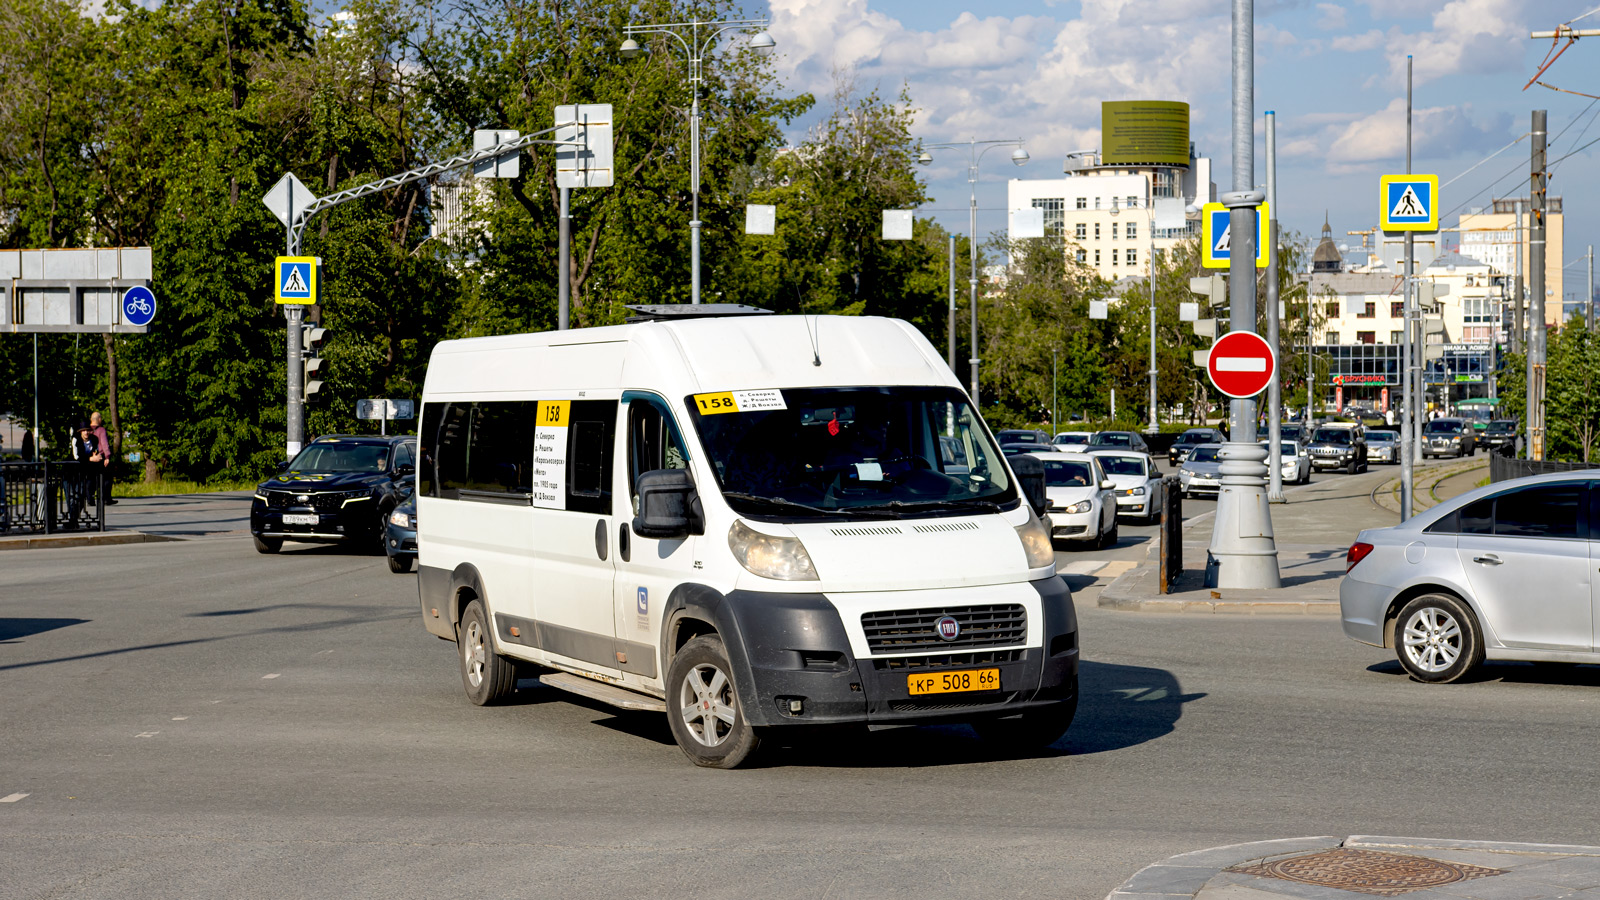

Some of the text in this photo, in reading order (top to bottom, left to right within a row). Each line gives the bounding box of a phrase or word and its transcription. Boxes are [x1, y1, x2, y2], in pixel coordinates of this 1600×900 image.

[1344, 375, 1386, 383] БРУСНИКА
[699, 397, 733, 409] 158
[545, 405, 560, 422] 158
[539, 432, 555, 441] Северка
[538, 444, 553, 452] Решеты
[539, 480, 549, 488] 1905
[942, 623, 955, 634] FIAT
[916, 671, 994, 692] КР 508 66
